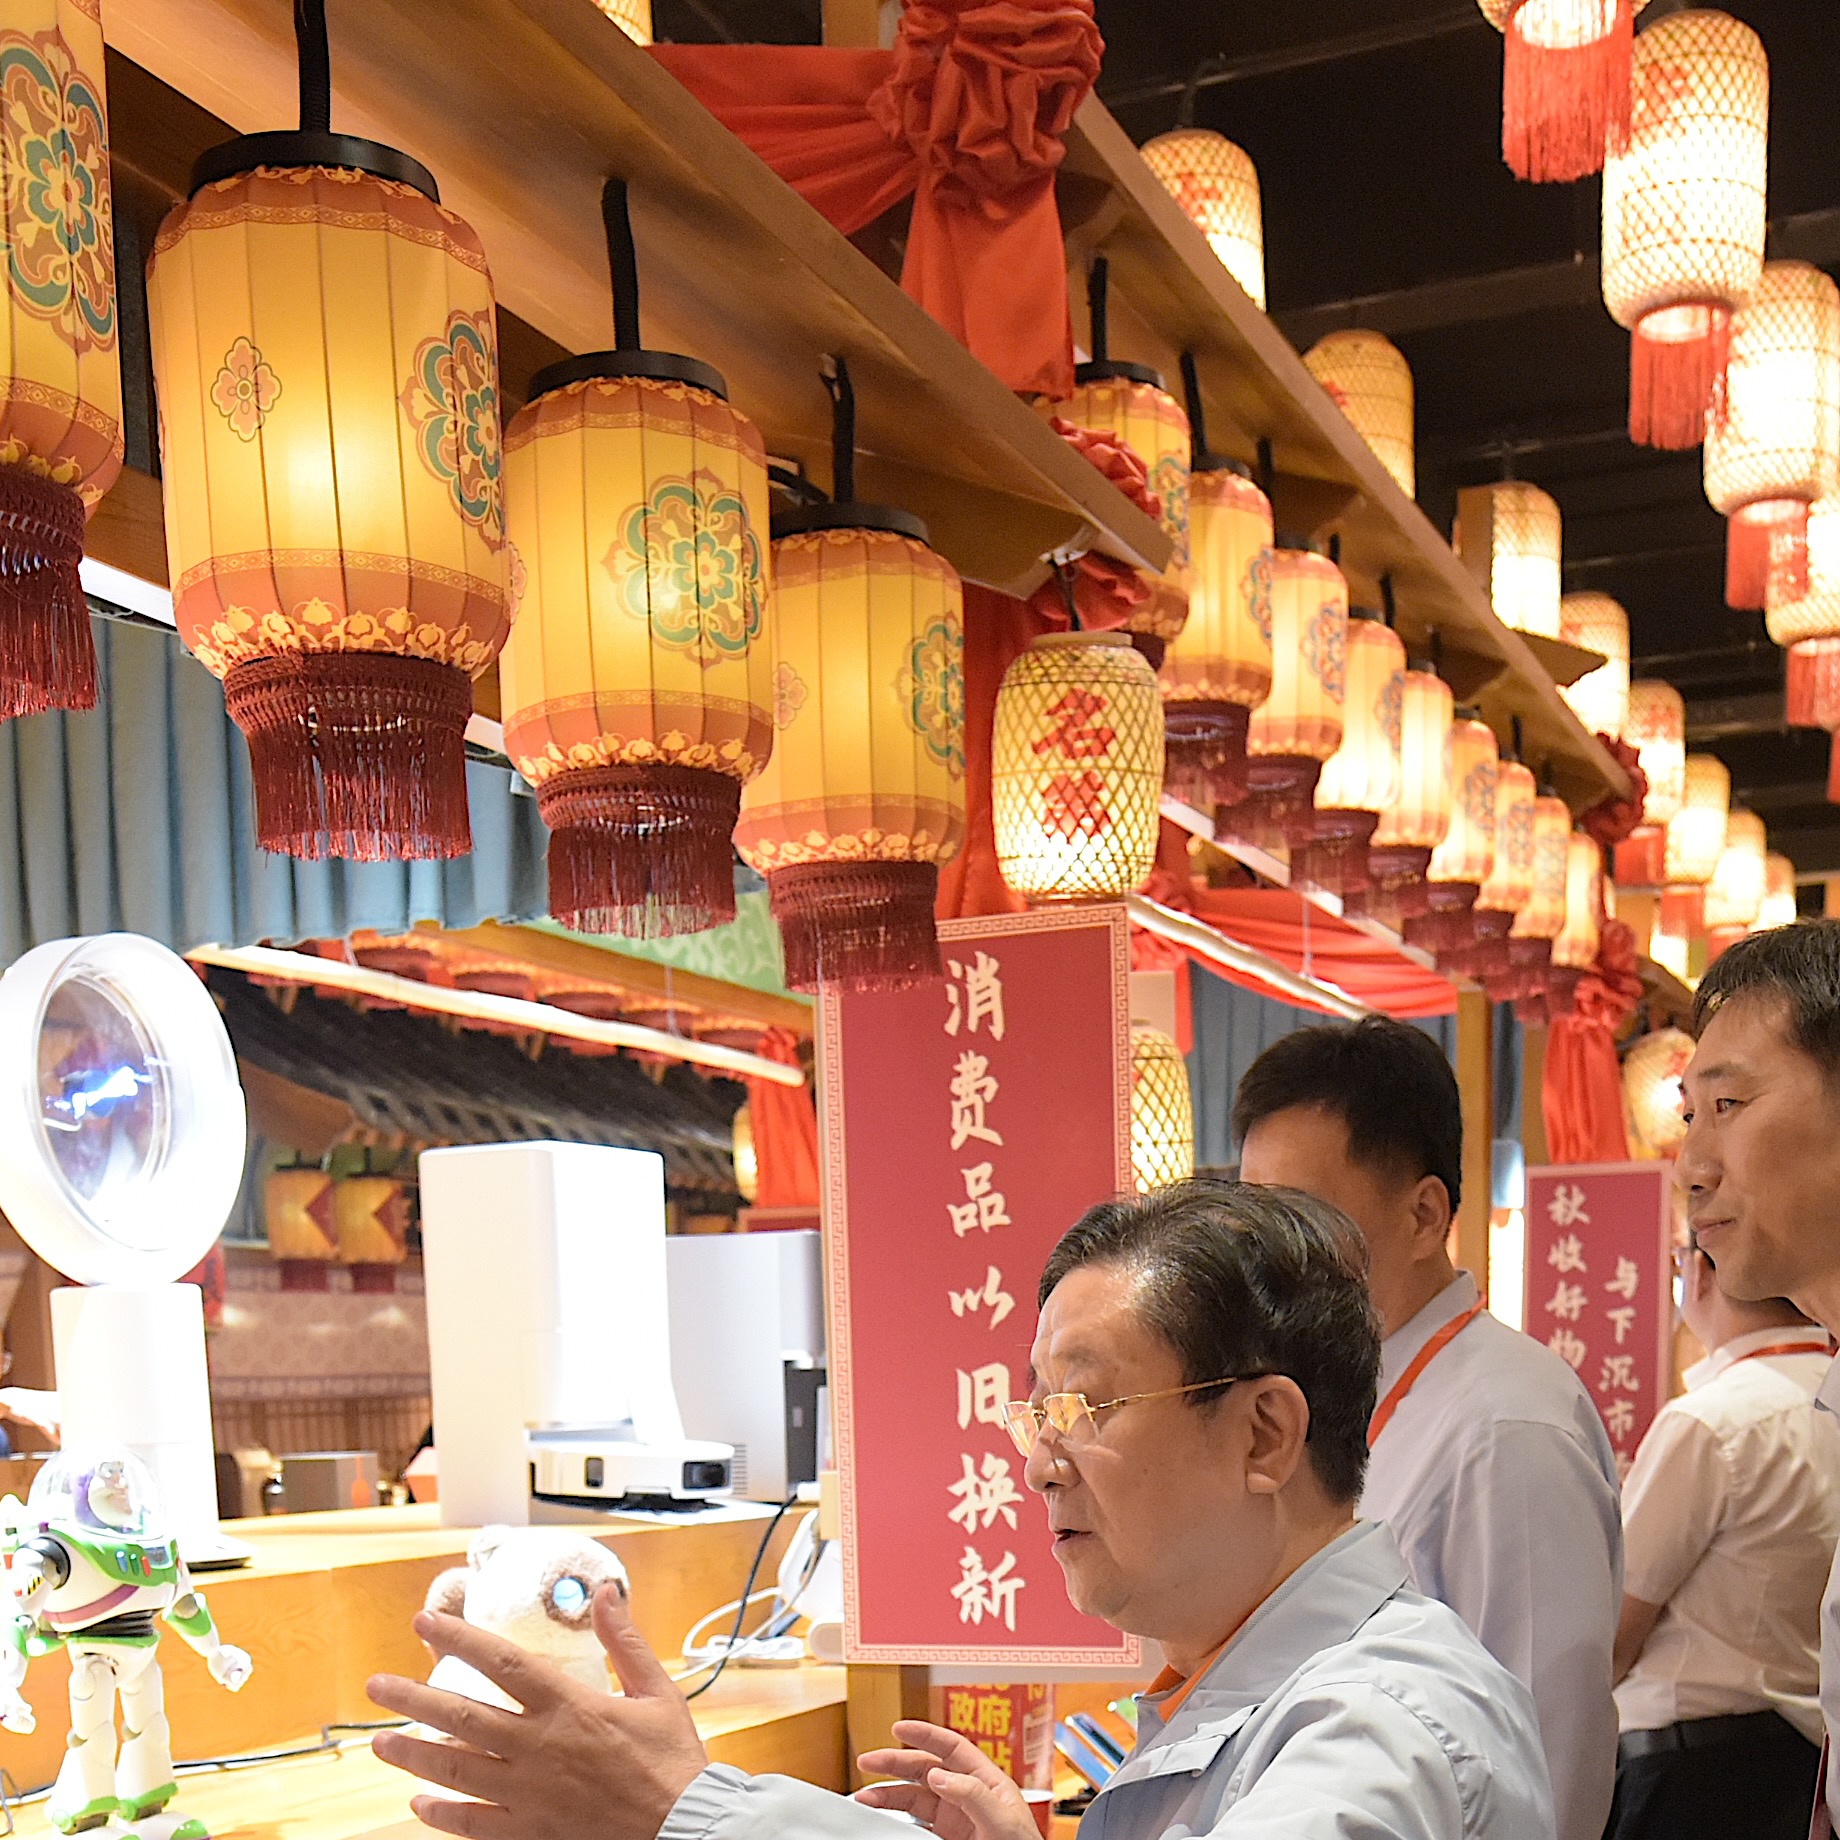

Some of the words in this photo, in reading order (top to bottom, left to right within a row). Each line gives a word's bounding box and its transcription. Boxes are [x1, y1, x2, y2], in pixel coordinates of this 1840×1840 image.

[942, 950, 1026, 1633] 消费品以旧换新
[1545, 1183, 1592, 1371] 秋收好物
[1597, 1254, 1640, 1480] 与下沉市
[948, 1691, 1013, 1737] 政府
